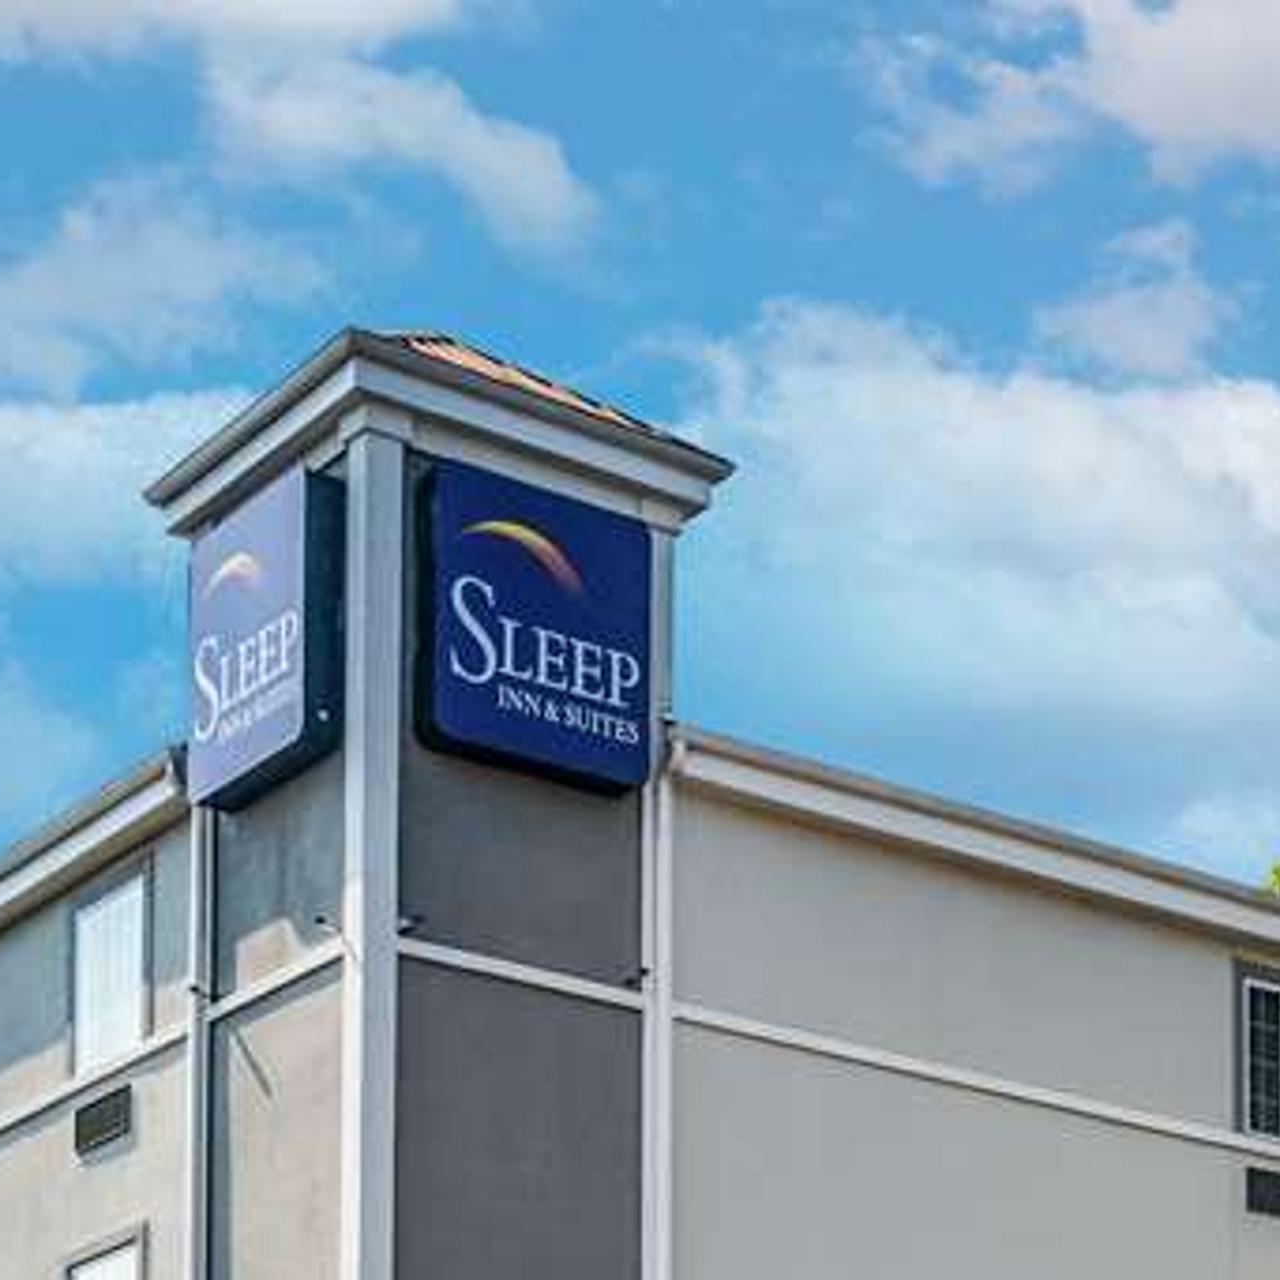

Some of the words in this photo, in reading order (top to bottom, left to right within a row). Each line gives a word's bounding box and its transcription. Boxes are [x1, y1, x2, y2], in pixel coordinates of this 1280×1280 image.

[194, 610, 297, 742] SLEEP
[450, 575, 640, 708] SLEEP
[496, 684, 541, 717] INN
[563, 705, 640, 744] SUITES
